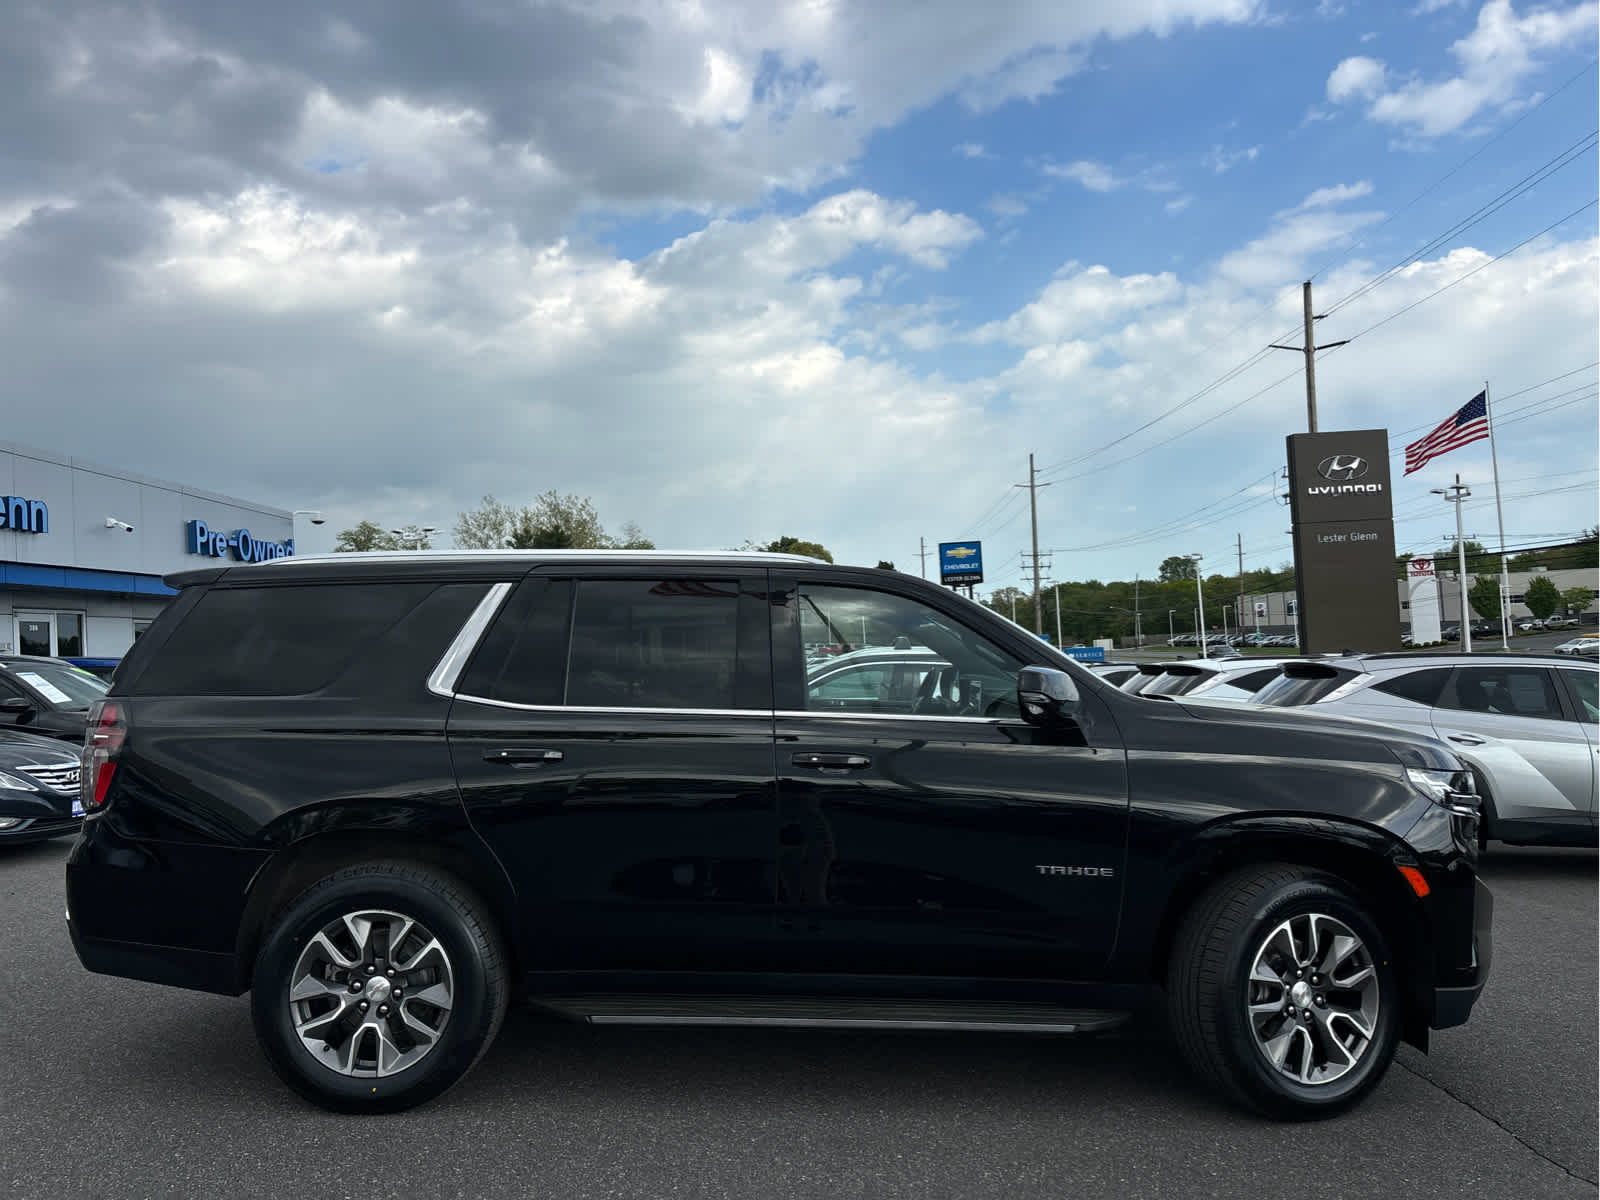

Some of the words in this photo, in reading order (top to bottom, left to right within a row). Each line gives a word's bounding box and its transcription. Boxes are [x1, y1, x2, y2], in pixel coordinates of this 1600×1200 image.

[1308, 483, 1382, 496] HYUNDAI
[187, 519, 295, 562] Pre-Owned
[1317, 534, 1347, 543] Lester
[1350, 532, 1378, 541] Glenn
[1035, 865, 1113, 877] TAHOE
